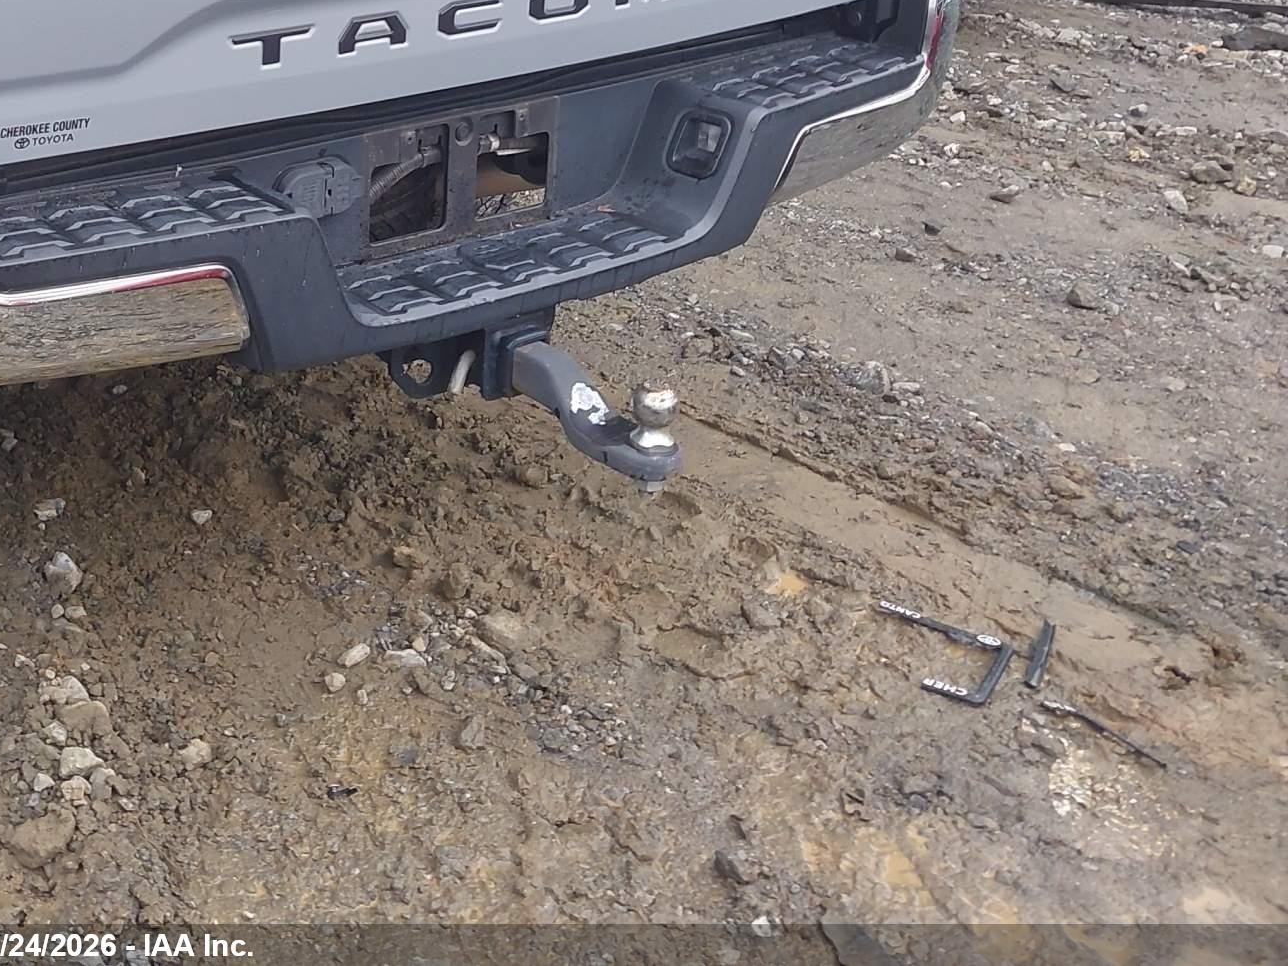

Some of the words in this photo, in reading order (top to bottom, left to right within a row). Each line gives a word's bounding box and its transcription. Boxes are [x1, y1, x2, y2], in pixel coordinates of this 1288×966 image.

[0, 123, 51, 138] CHEROKEE
[52, 117, 90, 133] COUNTY
[32, 134, 74, 146] TOYOTA
